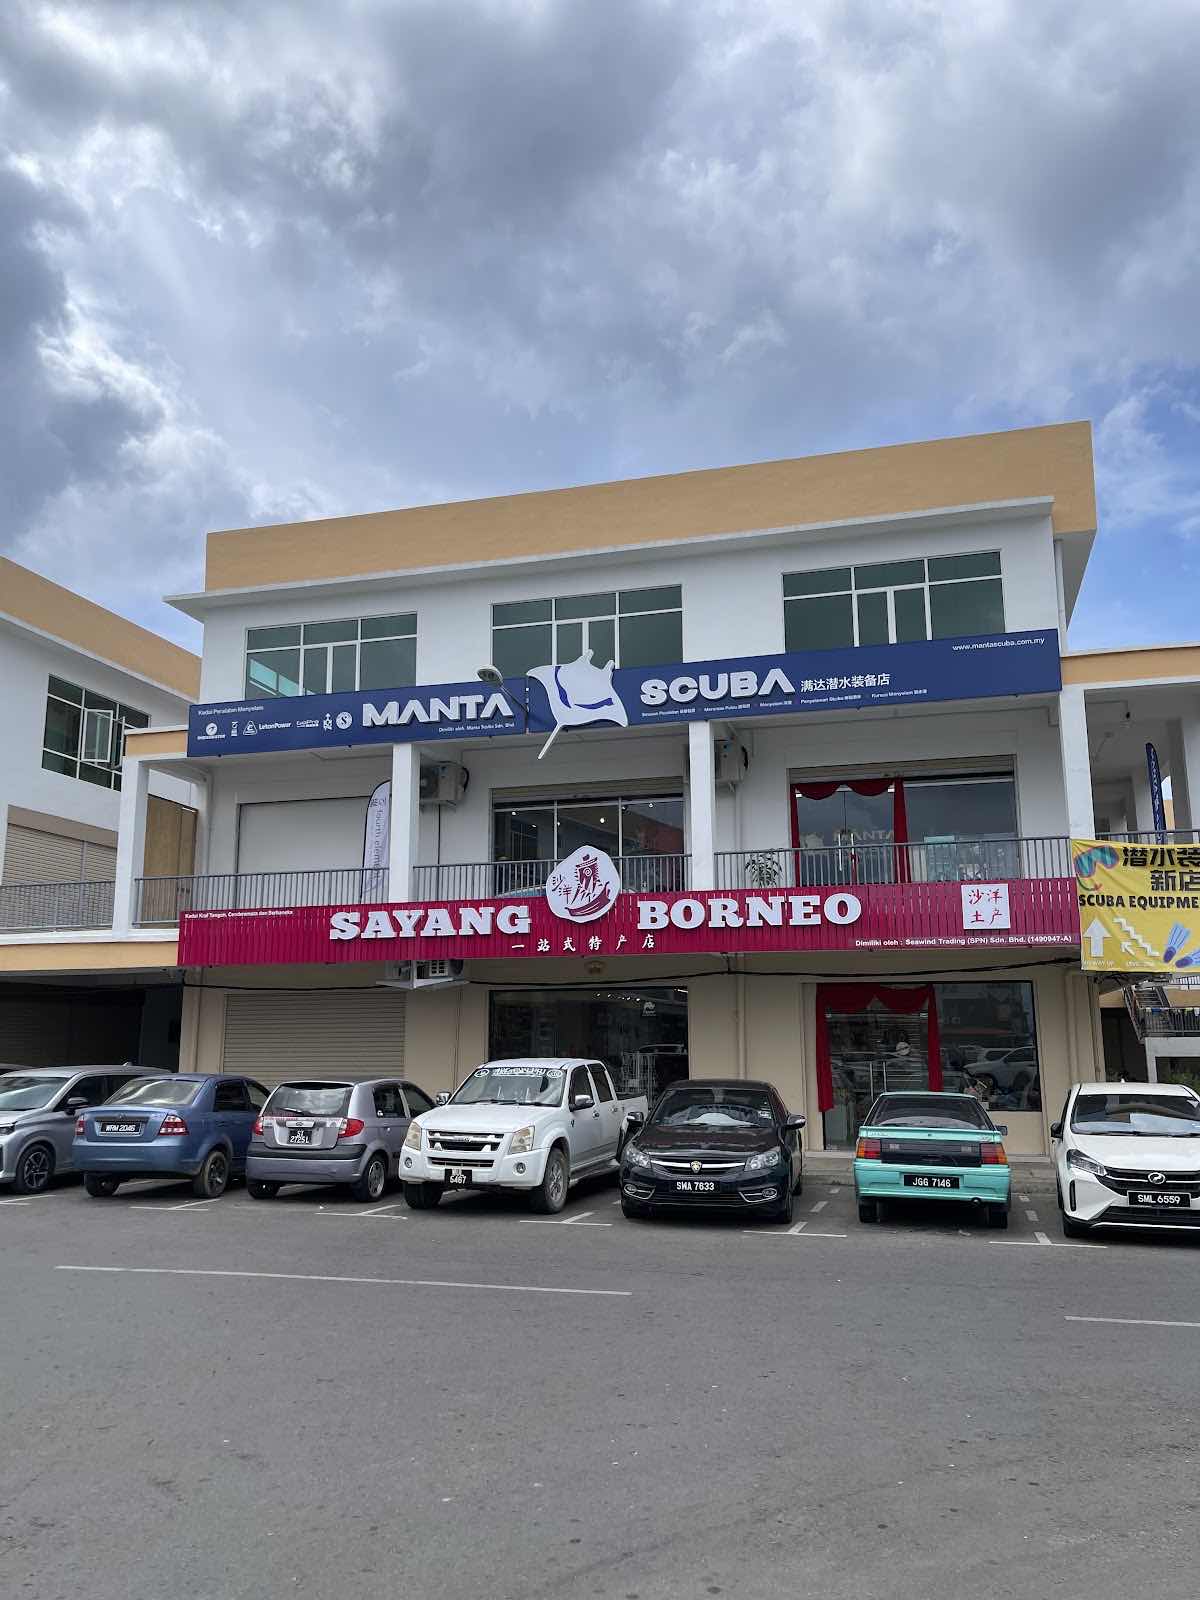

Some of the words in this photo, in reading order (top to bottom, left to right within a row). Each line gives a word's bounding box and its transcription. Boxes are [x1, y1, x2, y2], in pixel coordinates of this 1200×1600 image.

[952, 637, 1045, 651] www.mantascuba.com.my
[640, 668, 795, 706] SCUBA
[801, 673, 891, 693] 满达潜水装备店
[362, 692, 513, 727] MANTA
[1149, 870, 1200, 892] 新店
[968, 888, 1003, 905] 沙洋
[1078, 894, 1125, 908] SCUBA
[637, 892, 862, 930] BORNEO
[970, 910, 1003, 926] 土产
[330, 905, 532, 940] SAYANG
[511, 933, 656, 952] 一站式特产店
[905, 938, 936, 946] Seawind
[938, 938, 966, 946] Trading
[990, 936, 1007, 944] Sdn.
[1008, 936, 1026, 944] Bhd.
[694, 1182, 714, 1190] 7633
[912, 1177, 928, 1186] JGG
[932, 1178, 950, 1188] 7146
[1138, 1194, 1156, 1204] SML
[1157, 1195, 1180, 1204] 6559
